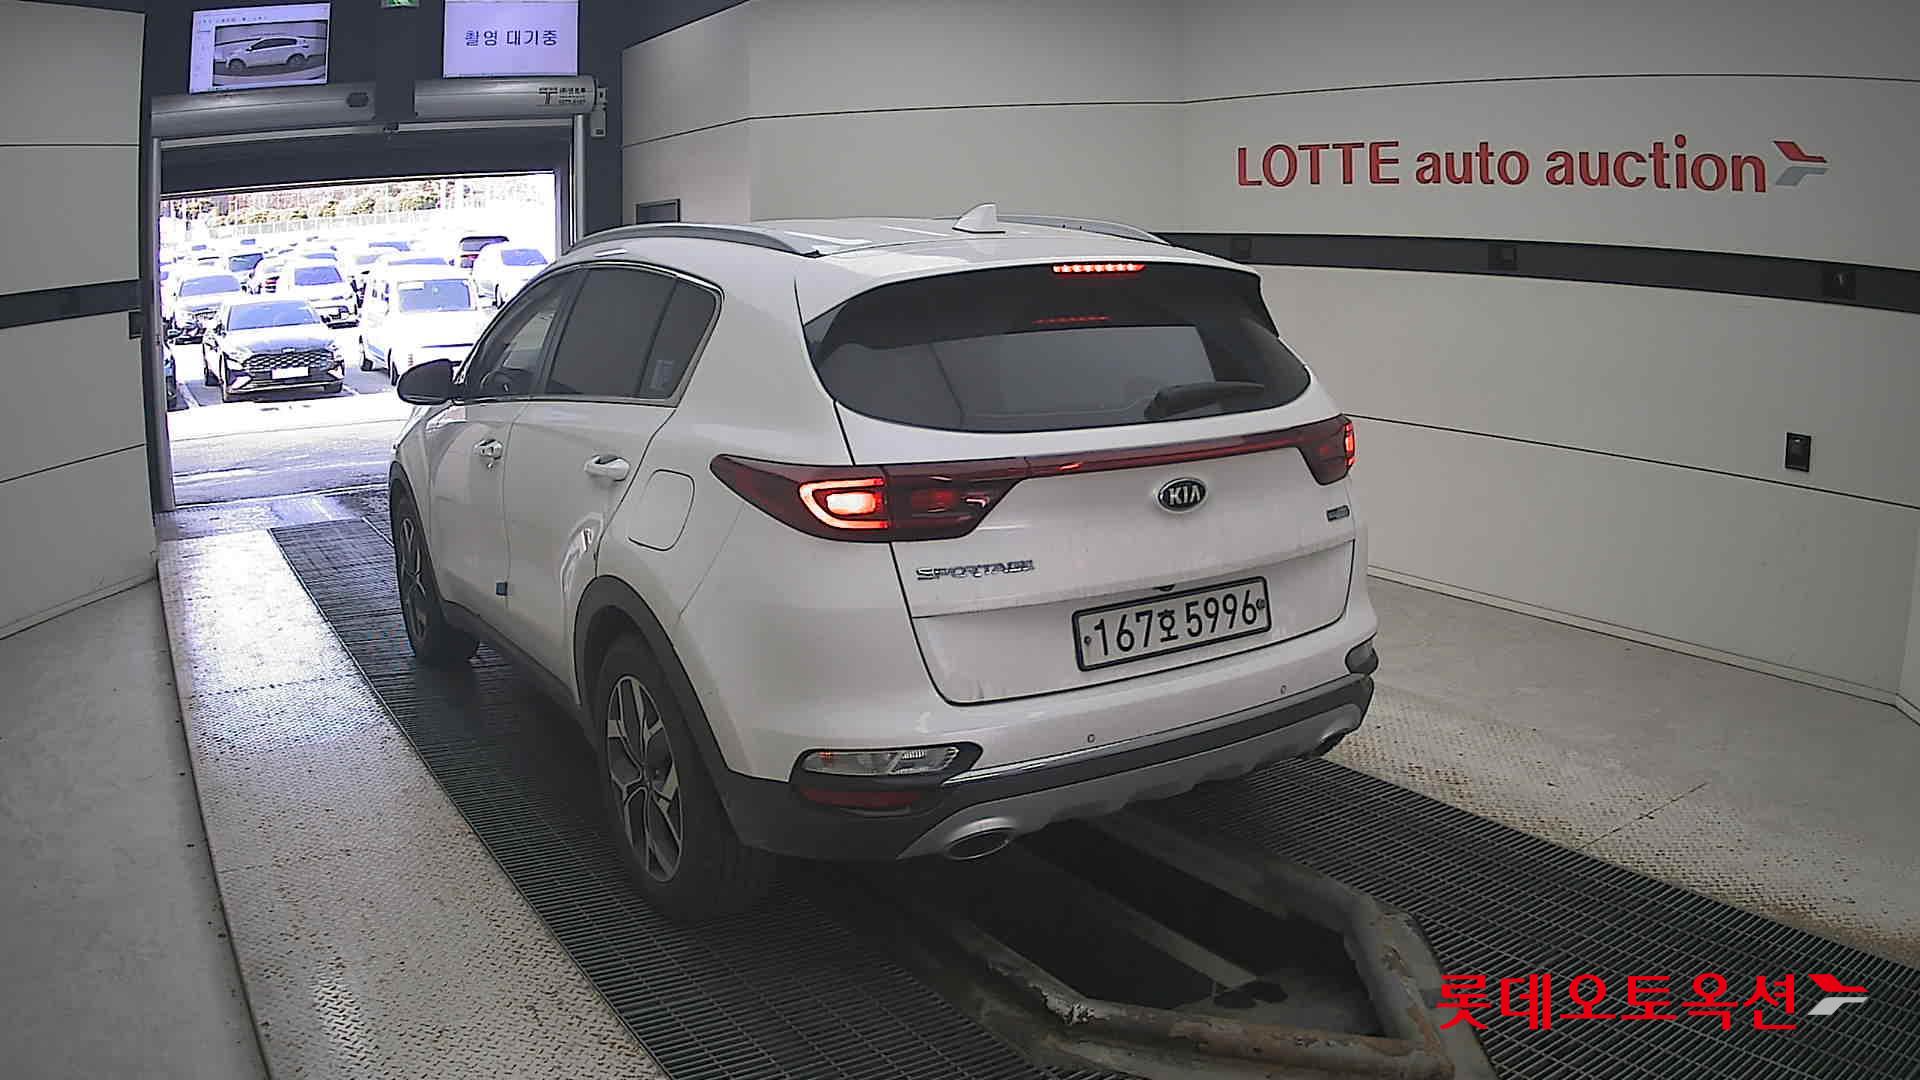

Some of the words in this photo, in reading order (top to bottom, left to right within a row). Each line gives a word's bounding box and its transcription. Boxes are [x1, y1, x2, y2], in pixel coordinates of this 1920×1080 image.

[465, 29, 498, 47] 촬영
[505, 29, 557, 46] 대기중
[1237, 140, 1400, 188] LOTTE
[1415, 141, 1531, 186] auto
[1545, 134, 1767, 193] auction
[1167, 484, 1202, 507] KIA
